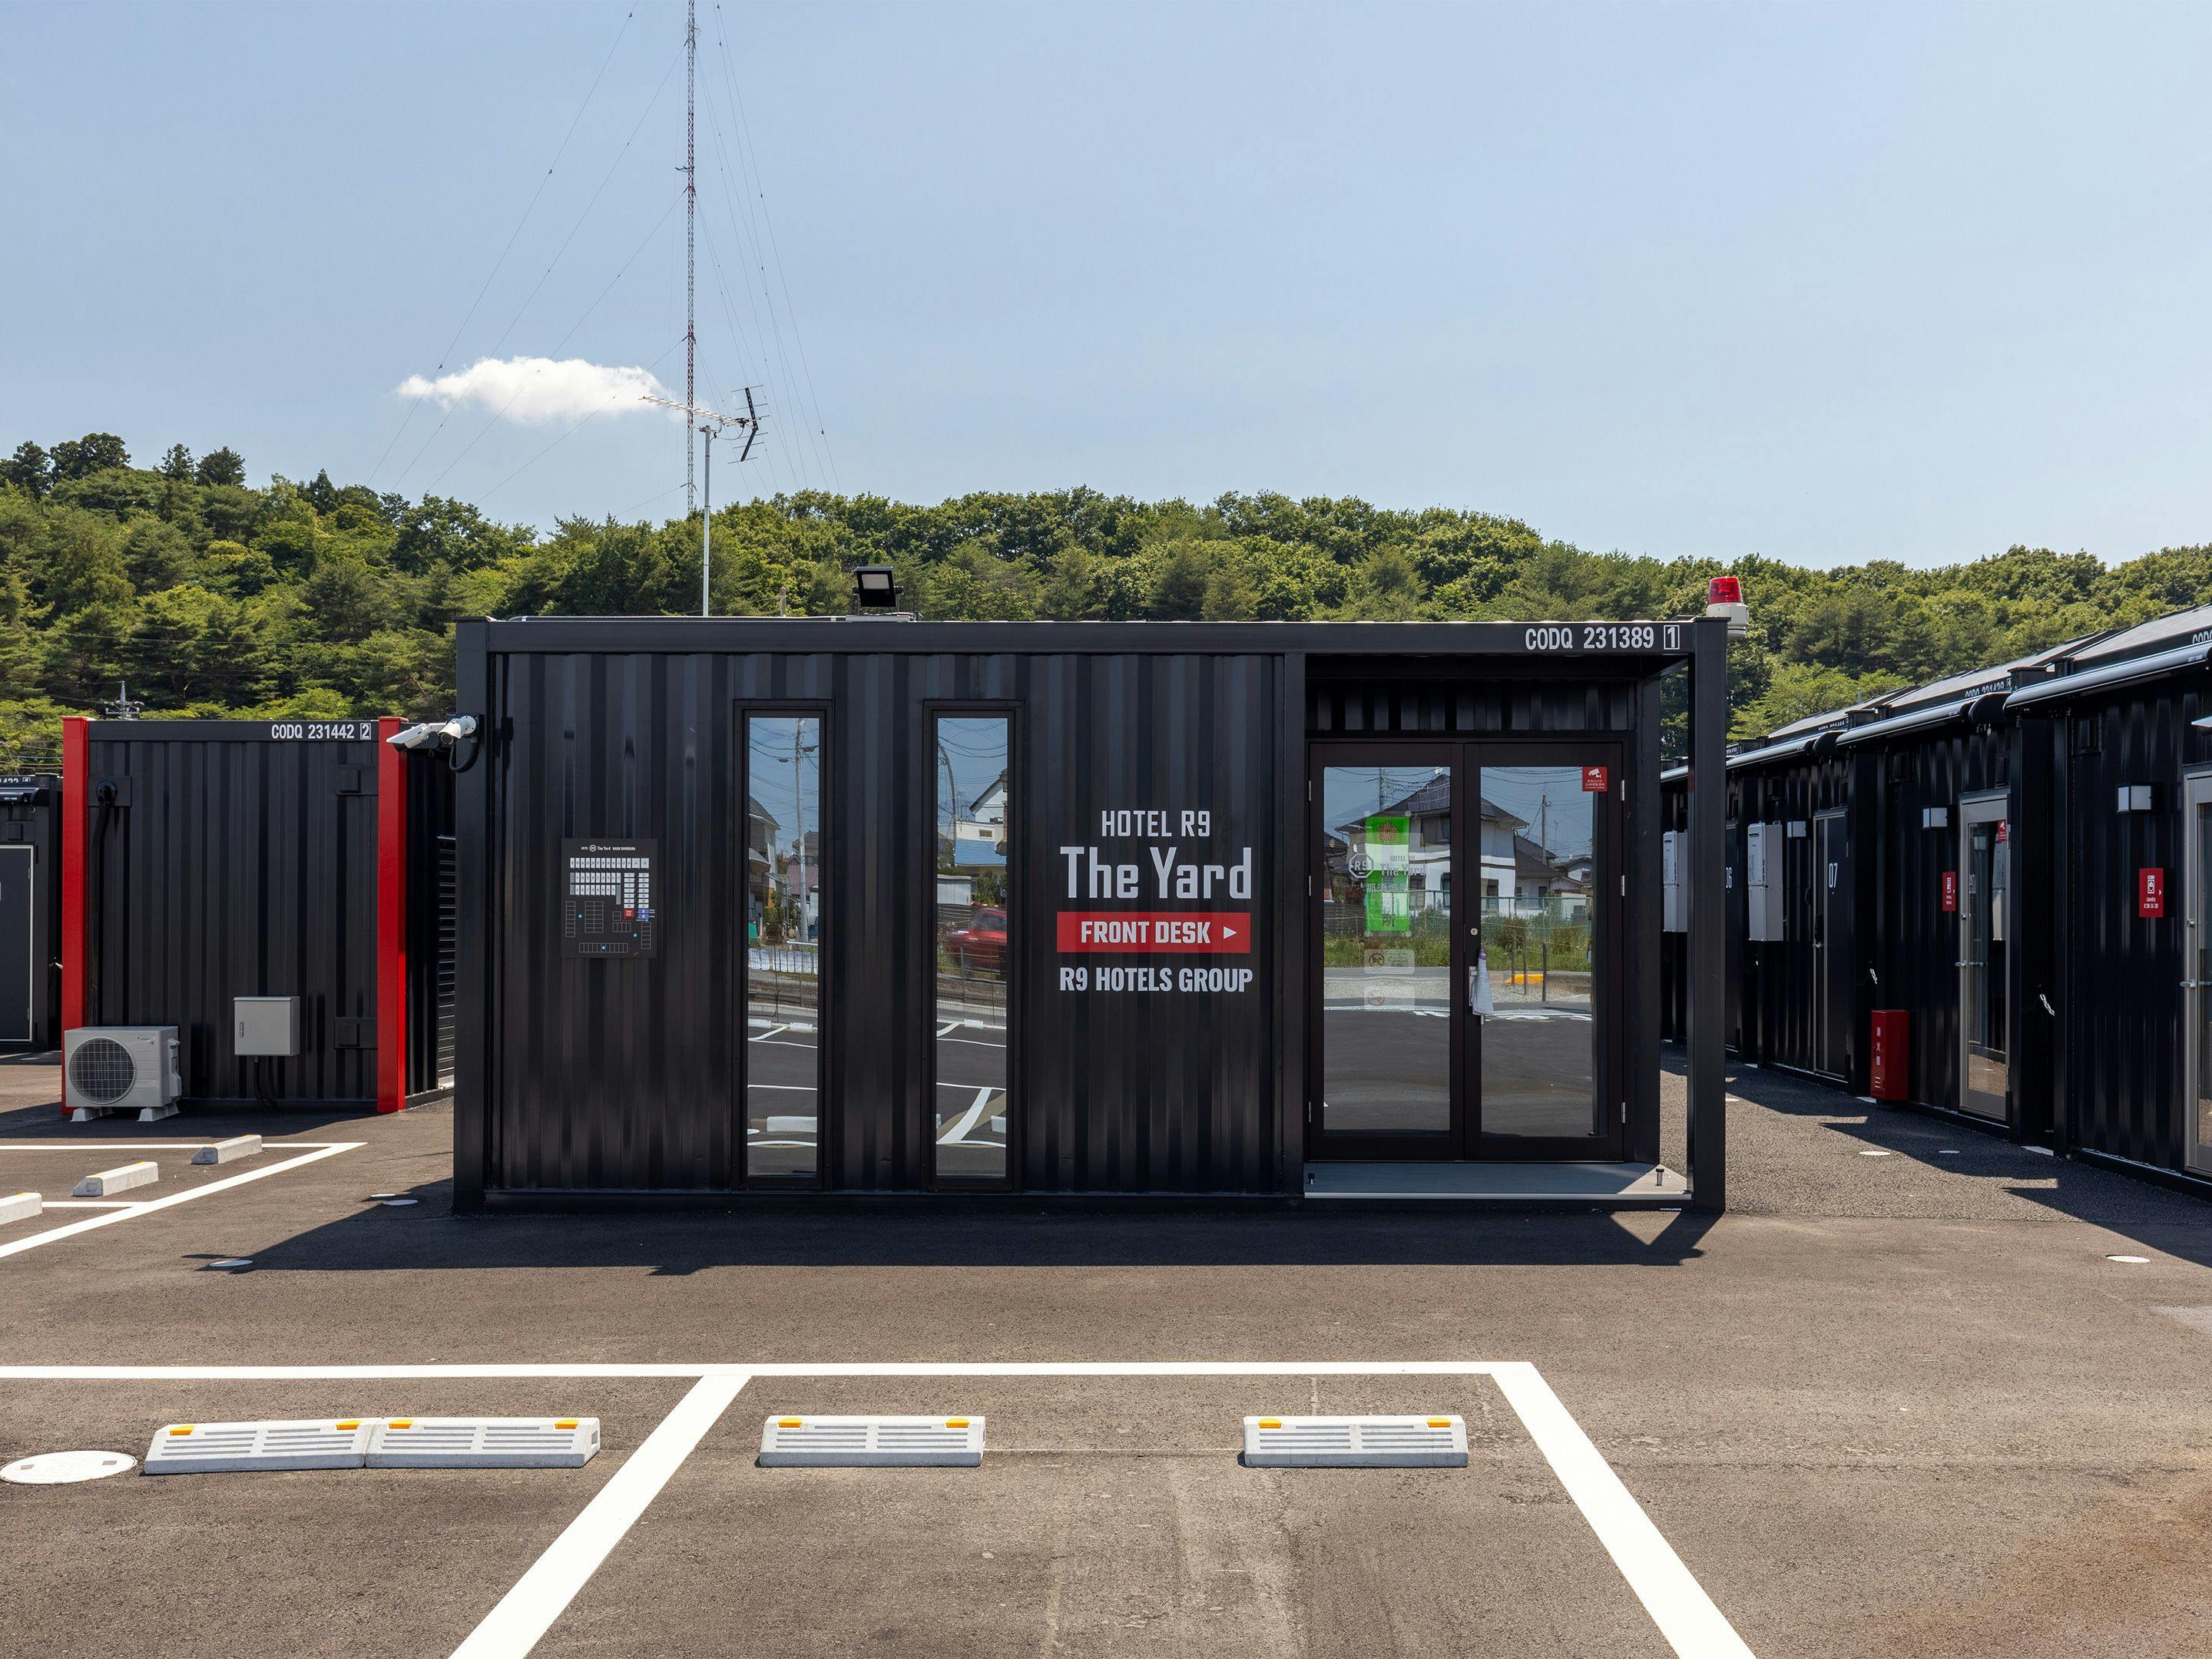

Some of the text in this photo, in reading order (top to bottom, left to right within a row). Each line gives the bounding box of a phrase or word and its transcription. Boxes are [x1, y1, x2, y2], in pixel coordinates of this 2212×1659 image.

[1525, 628, 1573, 651] CODQ
[1584, 626, 1654, 649] 231389
[271, 724, 303, 739] CODQ
[307, 724, 355, 739] 231442
[1101, 810, 1210, 837] HOTEL R9
[1060, 846, 1252, 899] The Yard
[1354, 861, 1368, 871] R9
[1380, 863, 1426, 876] The Yard
[1829, 863, 1838, 888] 07
[1081, 921, 1210, 944] FRONT DESK
[1060, 967, 1253, 992] R9 HOTELS GROUP
